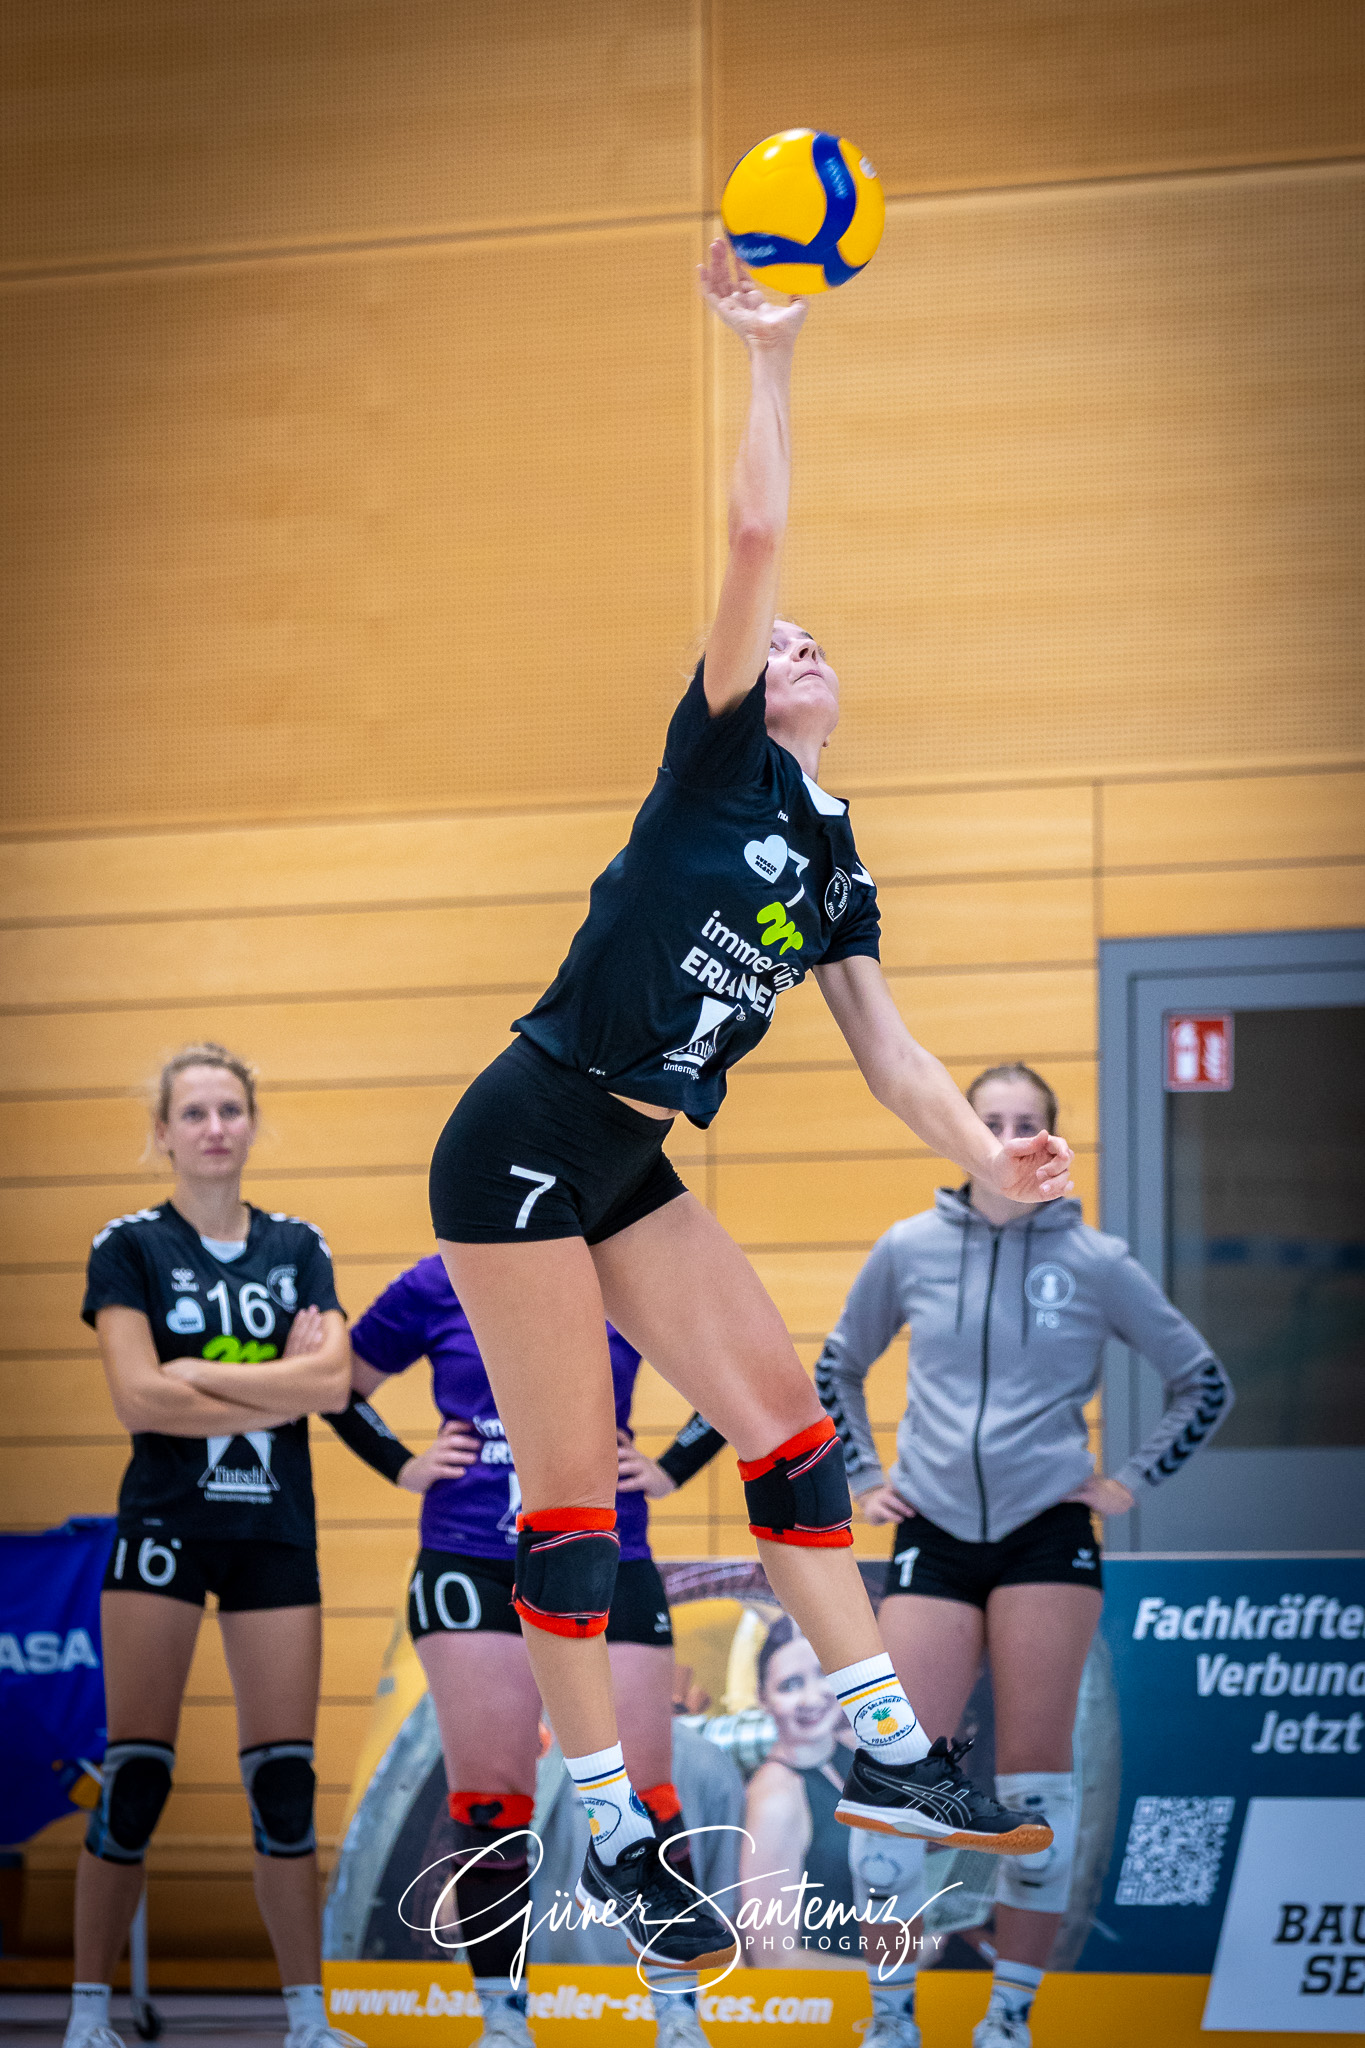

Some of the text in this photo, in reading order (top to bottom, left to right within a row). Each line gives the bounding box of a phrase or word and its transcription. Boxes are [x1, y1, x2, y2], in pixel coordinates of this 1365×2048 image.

[510, 1164, 556, 1229] 7
[206, 1279, 276, 1339] 16
[114, 1537, 182, 1587] 16
[894, 1546, 921, 1588] 1
[409, 1571, 483, 1630] 10
[1132, 1593, 1365, 1641] Fachkräfte
[1251, 1710, 1365, 1755] Jetzt
